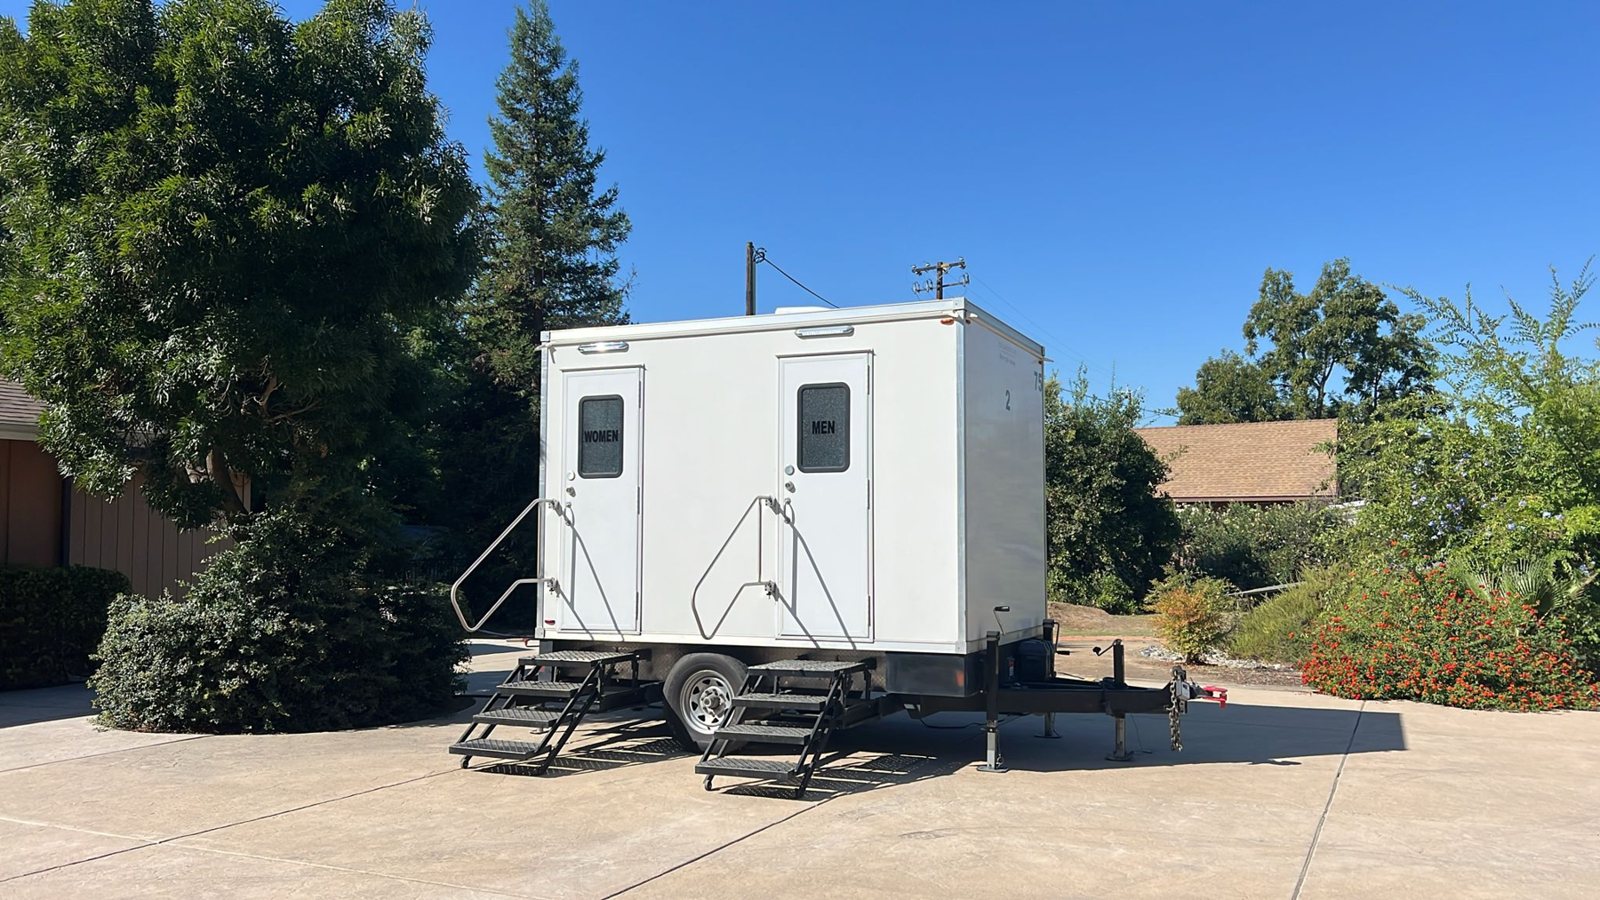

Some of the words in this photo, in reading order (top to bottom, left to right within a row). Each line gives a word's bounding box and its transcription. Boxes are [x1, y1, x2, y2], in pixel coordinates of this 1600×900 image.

[1005, 389, 1011, 411] 2
[811, 420, 835, 435] MEN
[584, 429, 619, 443] WOMEN
